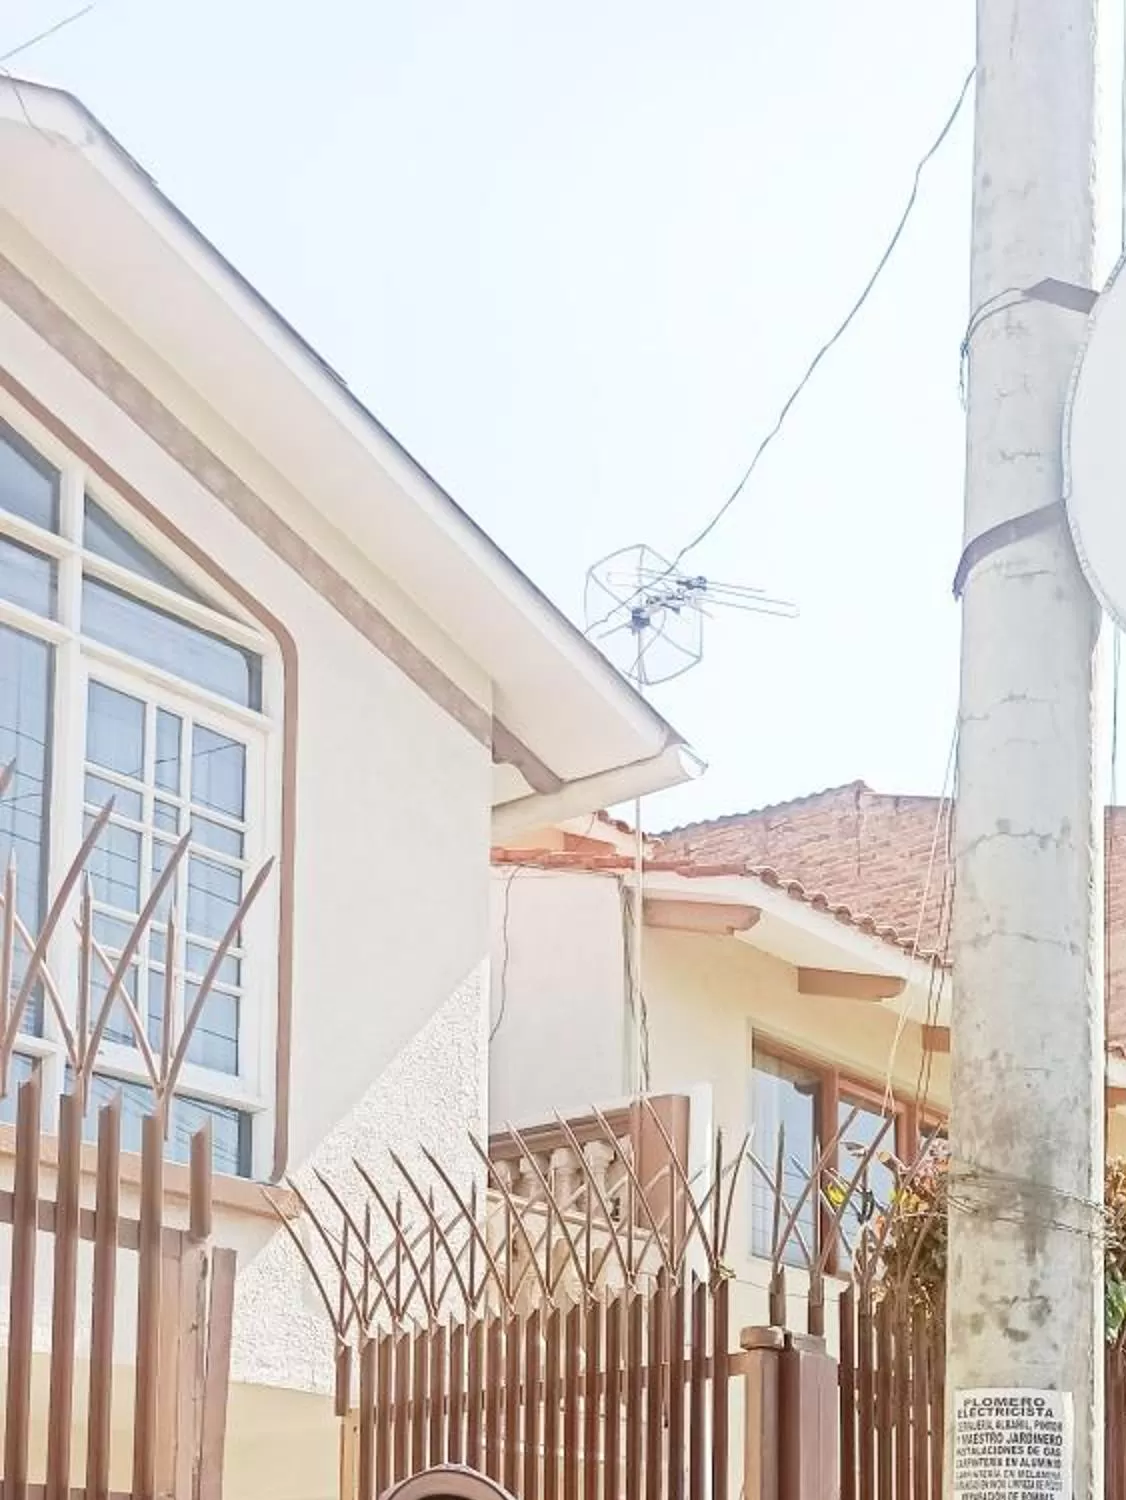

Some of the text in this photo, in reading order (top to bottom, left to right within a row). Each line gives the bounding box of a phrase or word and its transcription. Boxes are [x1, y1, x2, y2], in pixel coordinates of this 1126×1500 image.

[963, 1397, 1046, 1407] PLOMERO
[957, 1407, 1055, 1418] ELECTRICISTA
[962, 1432, 1004, 1445] MAESTRO
[1006, 1432, 1063, 1446] JARDINERO
[1027, 1446, 1041, 1456] DE
[1043, 1447, 1062, 1457] GAS
[1005, 1457, 1018, 1467] EN
